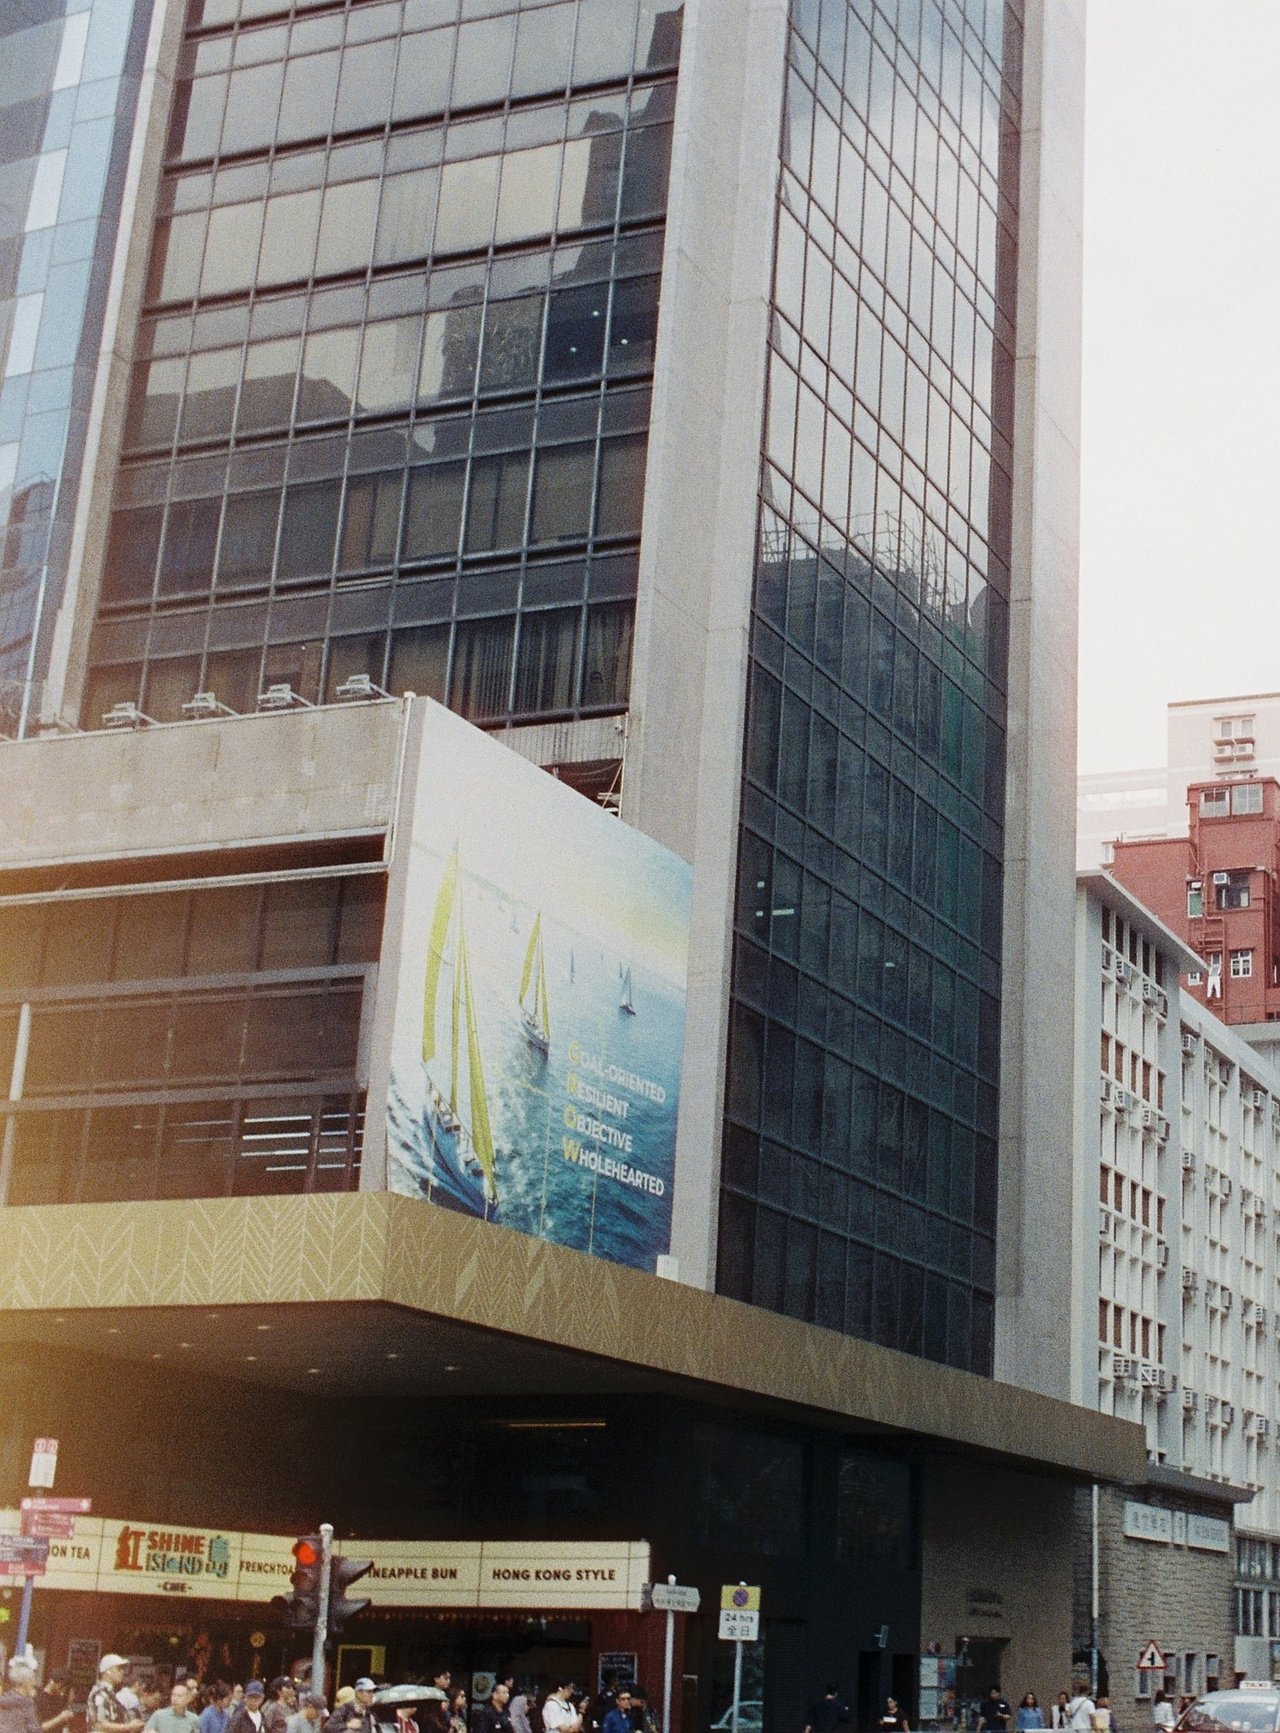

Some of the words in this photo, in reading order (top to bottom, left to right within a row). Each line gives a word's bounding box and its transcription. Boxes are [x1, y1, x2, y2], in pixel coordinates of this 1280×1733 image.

[566, 1072, 629, 1119] RESILIENT
[564, 1105, 633, 1152] OBJECTIVE
[562, 1136, 665, 1197] WHOLEHEARTED
[147, 1531, 206, 1555] SHINE
[71, 1546, 90, 1560] TEA
[277, 1563, 294, 1575] TOA
[368, 1567, 427, 1580] INEAPPLE
[432, 1567, 458, 1580] BUN
[492, 1569, 530, 1581] HONG
[535, 1569, 572, 1581] KONG
[576, 1569, 616, 1581] STYLE
[725, 1613, 737, 1622] 24
[740, 1614, 754, 1623] hrs
[727, 1625, 750, 1637] 全日
